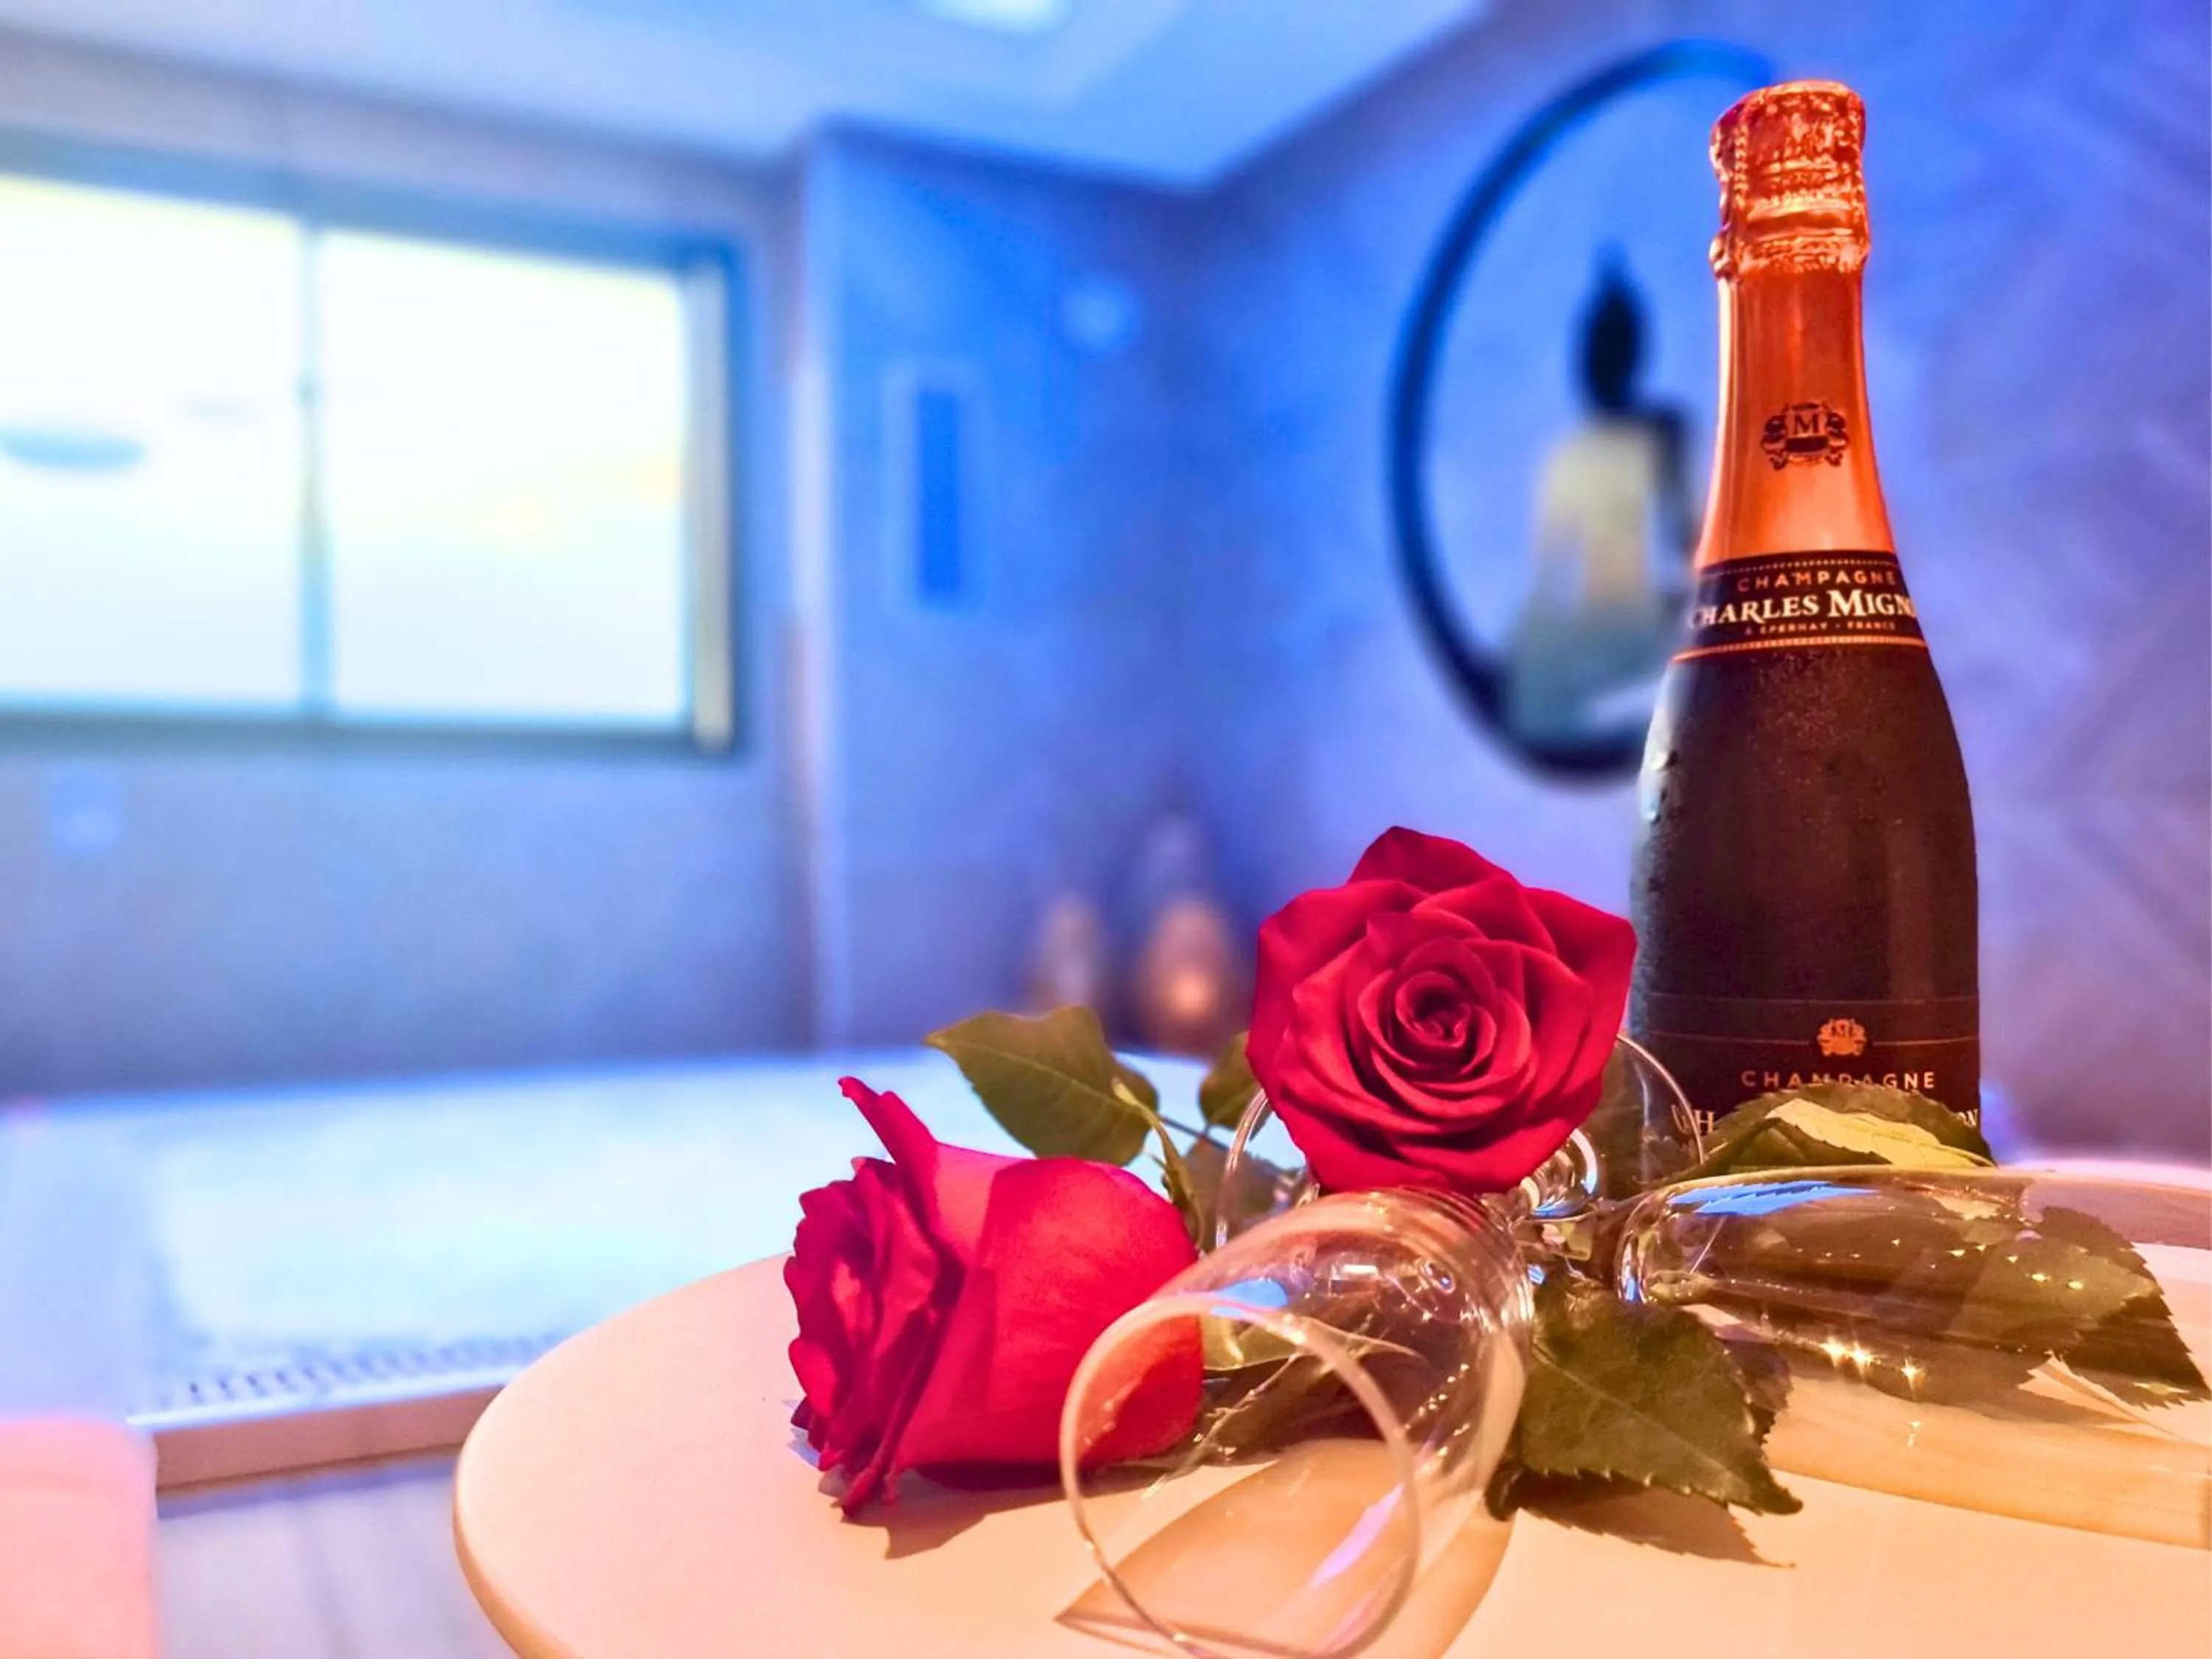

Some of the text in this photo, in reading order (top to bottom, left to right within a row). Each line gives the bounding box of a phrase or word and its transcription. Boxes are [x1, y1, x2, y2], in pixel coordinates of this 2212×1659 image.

[1793, 413, 1819, 435] M
[1737, 570, 1896, 591] CHAMPAGNE
[1847, 621, 1896, 630] FRANCE
